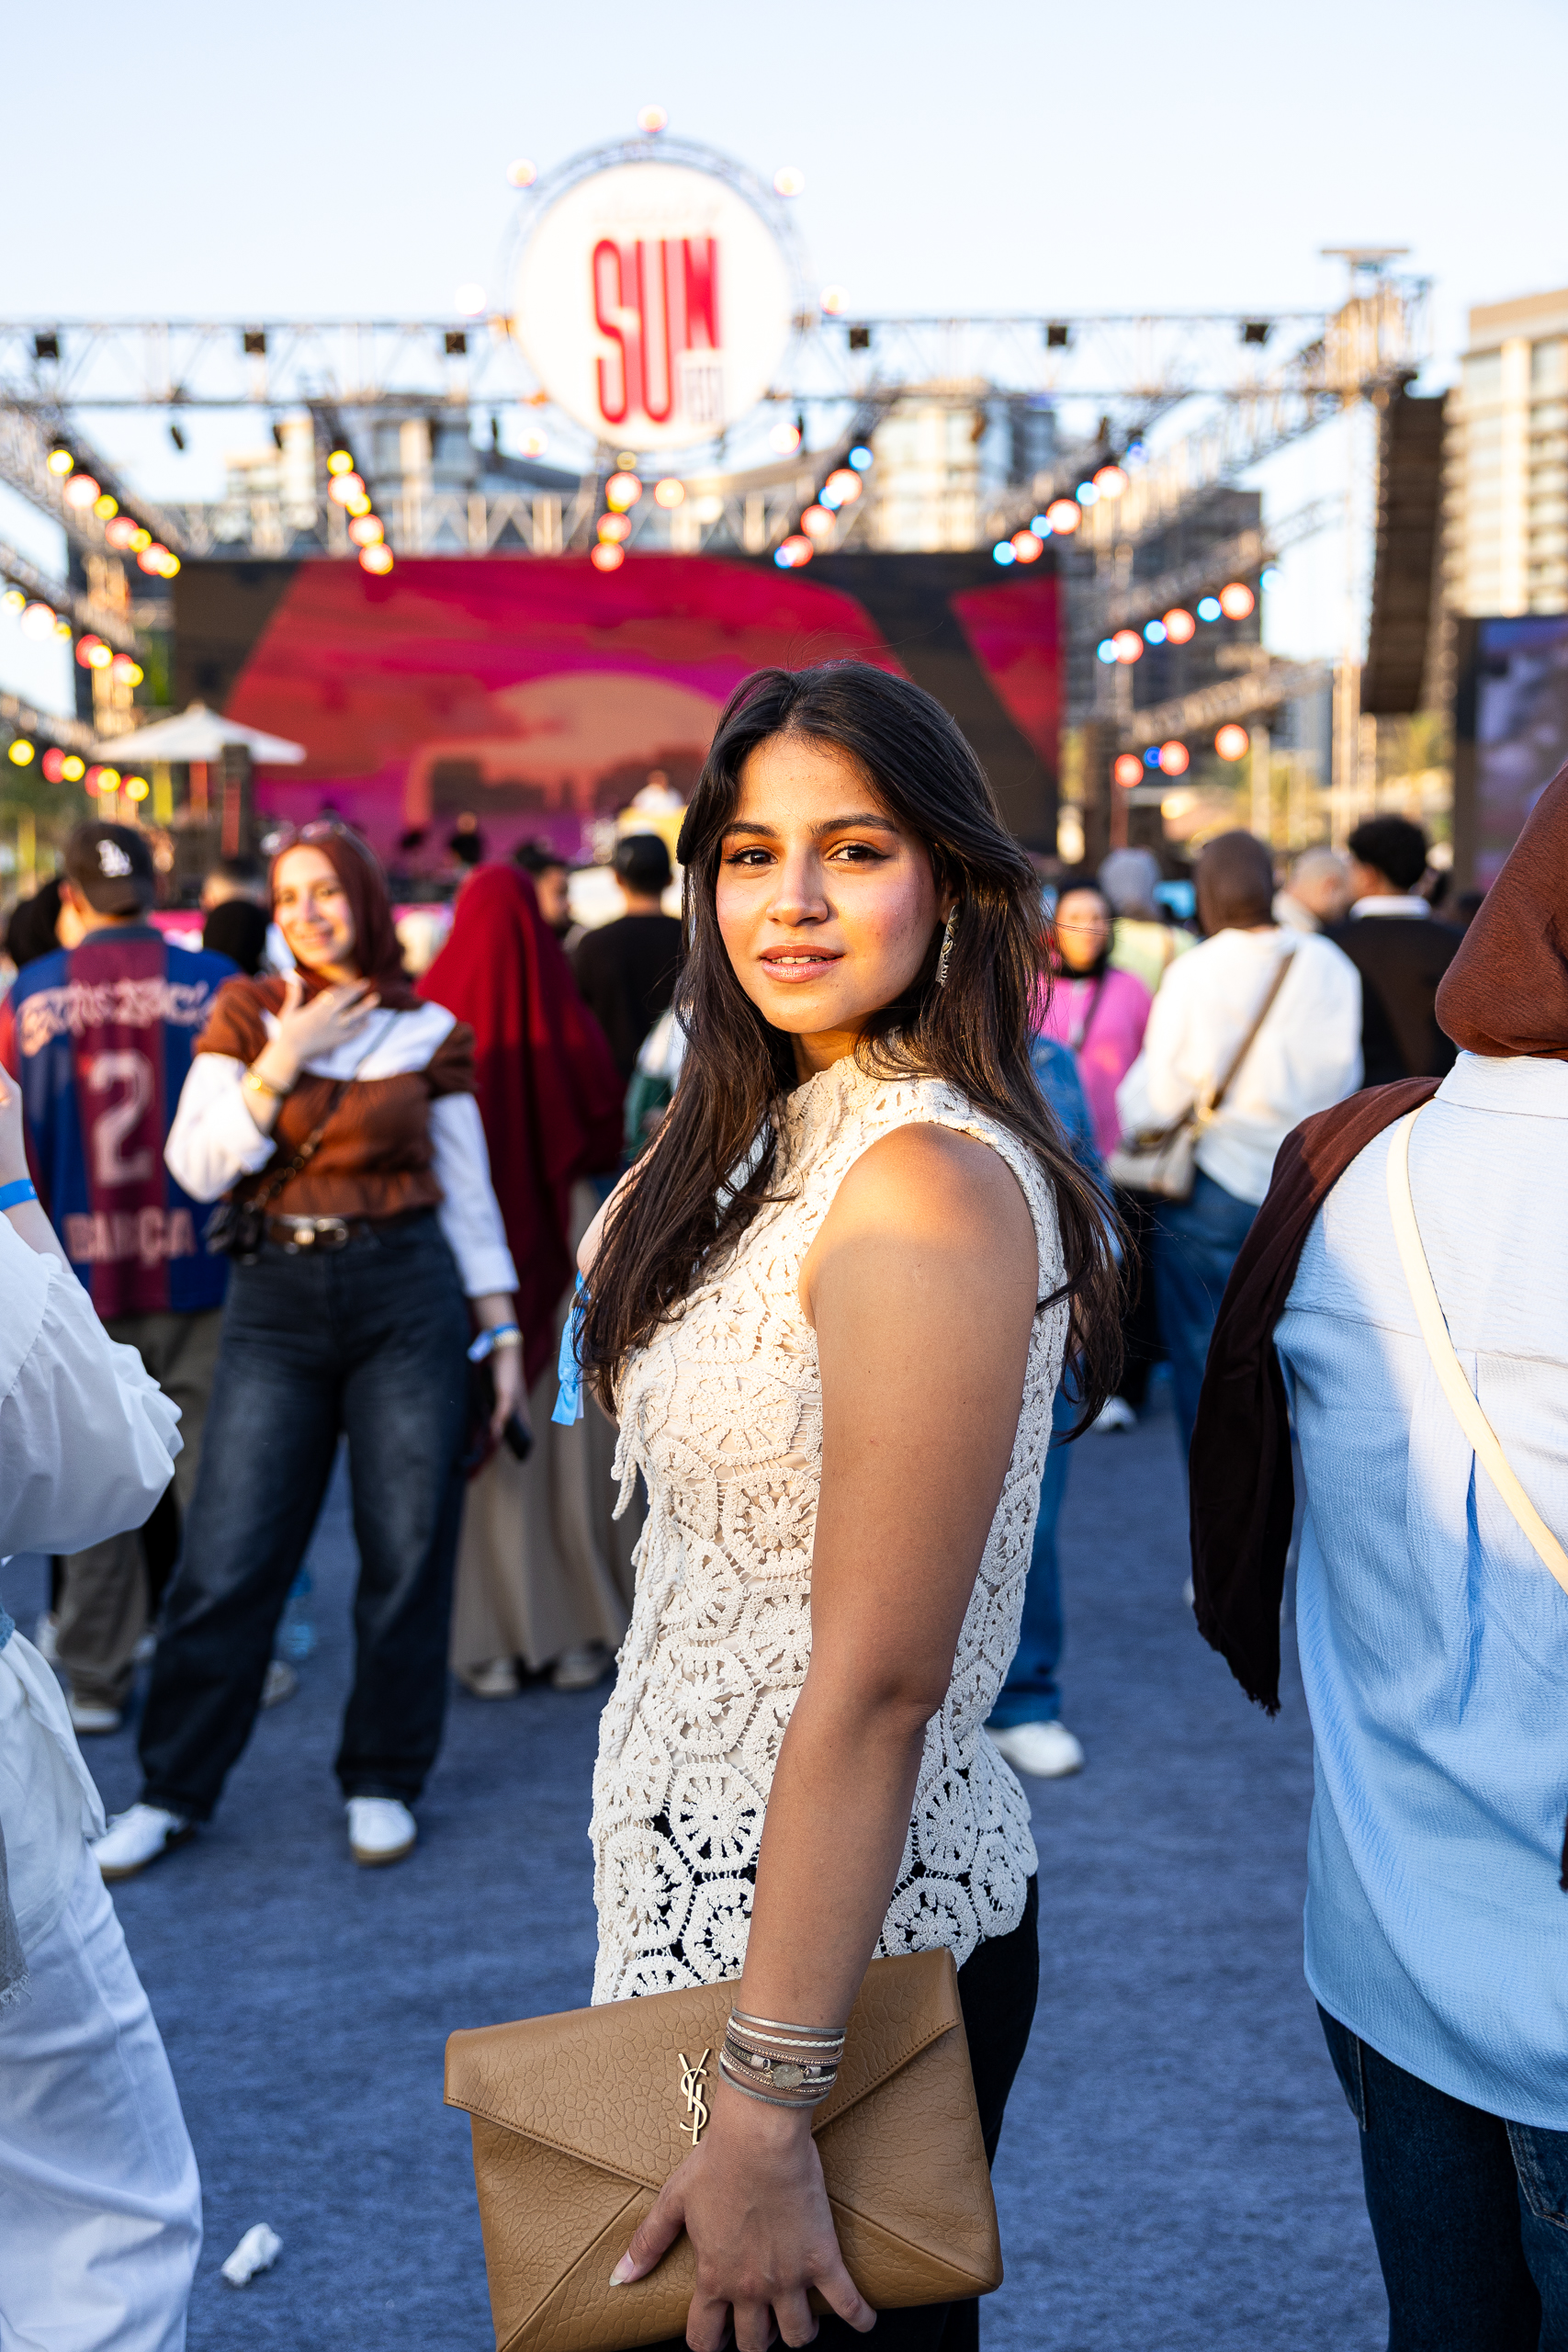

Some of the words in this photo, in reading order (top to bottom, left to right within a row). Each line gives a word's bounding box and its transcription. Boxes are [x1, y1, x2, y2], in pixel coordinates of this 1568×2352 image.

[592, 237, 721, 424] SUN
[89, 1049, 155, 1187] 2
[678, 2048, 710, 2145] YSL
